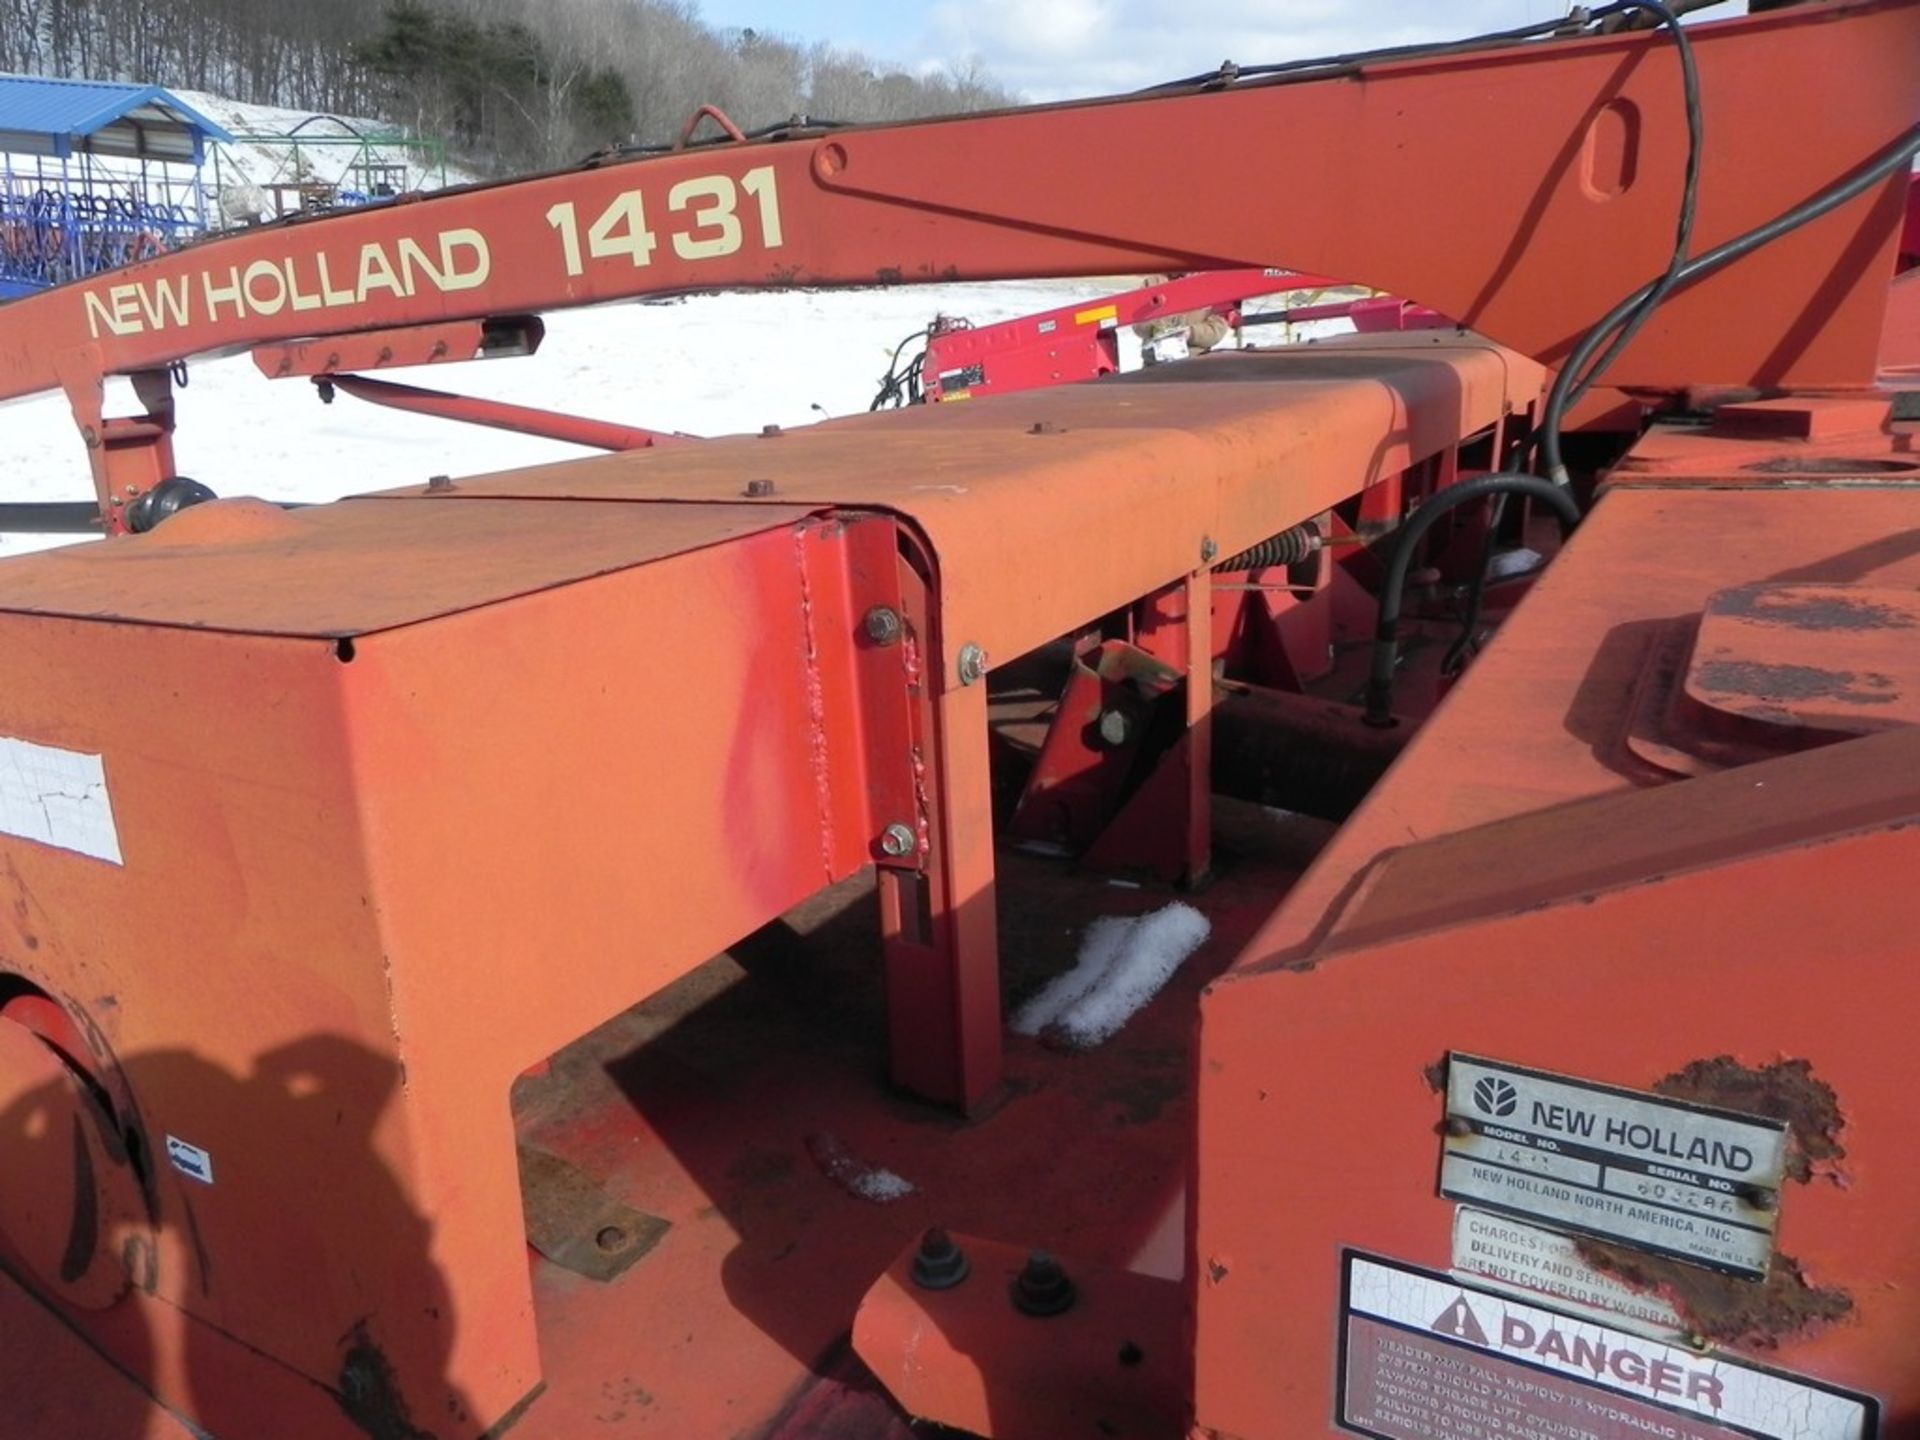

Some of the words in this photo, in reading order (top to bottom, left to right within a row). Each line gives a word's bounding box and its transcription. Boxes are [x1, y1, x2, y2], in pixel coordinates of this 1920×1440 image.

[83, 274, 190, 338] NEW
[202, 228, 490, 321] HOLLAND
[546, 166, 783, 276] 1431
[1483, 1125, 1530, 1145] MODEL
[1536, 1138, 1561, 1152] NO.
[1532, 1101, 1596, 1138] NEW
[1605, 1118, 1753, 1172] HOLLAND
[1647, 1165, 1700, 1184] SERIAL
[1708, 1179, 1736, 1193] NO.
[1472, 1167, 1502, 1183] NEW
[1506, 1175, 1570, 1201] HOLLAND
[1574, 1193, 1623, 1215] NORTH
[1627, 1206, 1698, 1236] AMERICA,
[1705, 1225, 1735, 1244] INC.
[1469, 1219, 1537, 1249] CHARGES
[1458, 1256, 1486, 1272] ARE
[1488, 1263, 1517, 1283] NOT
[1520, 1271, 1587, 1300] COVERED
[1590, 1290, 1610, 1308] BY
[1471, 1239, 1540, 1269] DELIVERY
[1542, 1259, 1573, 1279] AND
[1377, 1352, 1430, 1376] SYSTEM
[1434, 1370, 1490, 1394] SHOULD
[1377, 1336, 1432, 1363] HEADER
[1434, 1354, 1464, 1371] MAY
[1468, 1365, 1500, 1384] FALL
[1506, 1377, 1565, 1403] RAPIDLY
[1586, 1401, 1677, 1439] HYDRAULIC
[1502, 1317, 1724, 1409] DANGER
[1375, 1379, 1439, 1409] WORKING
[1443, 1400, 1501, 1428] AROUND
[1375, 1394, 1429, 1420] FAILURE
[1432, 1411, 1450, 1426] TO
[1455, 1421, 1482, 1438] USE
[1377, 1366, 1429, 1391] ALWAYS
[1433, 1384, 1488, 1411] ENGAGE
[1493, 1402, 1521, 1420] LIFT
[1375, 1407, 1432, 1436] SERIOUS
